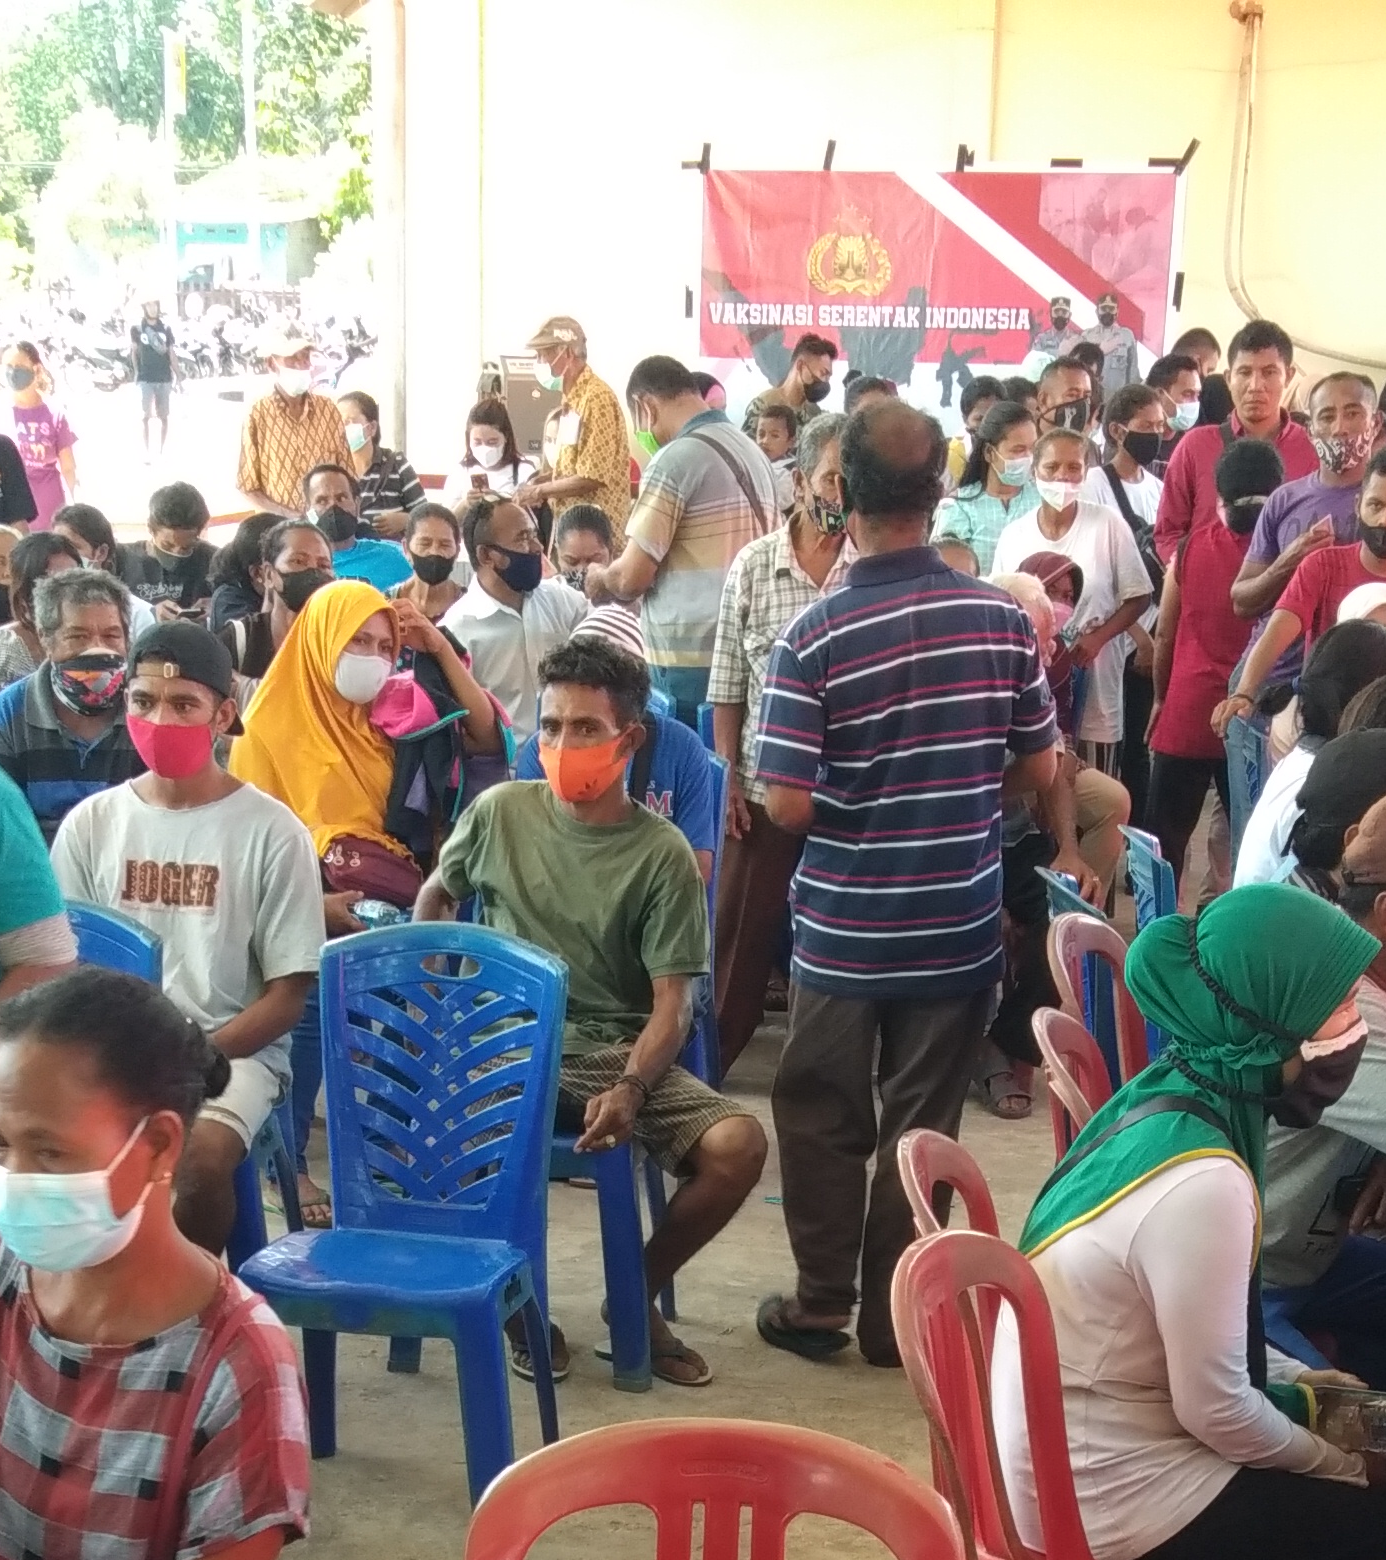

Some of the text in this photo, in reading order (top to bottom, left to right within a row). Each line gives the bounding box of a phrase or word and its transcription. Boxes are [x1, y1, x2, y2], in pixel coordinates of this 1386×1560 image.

[708, 302, 1031, 332] VAKSINASI SERENTAK INDONESIA
[121, 859, 220, 907] JOGER
